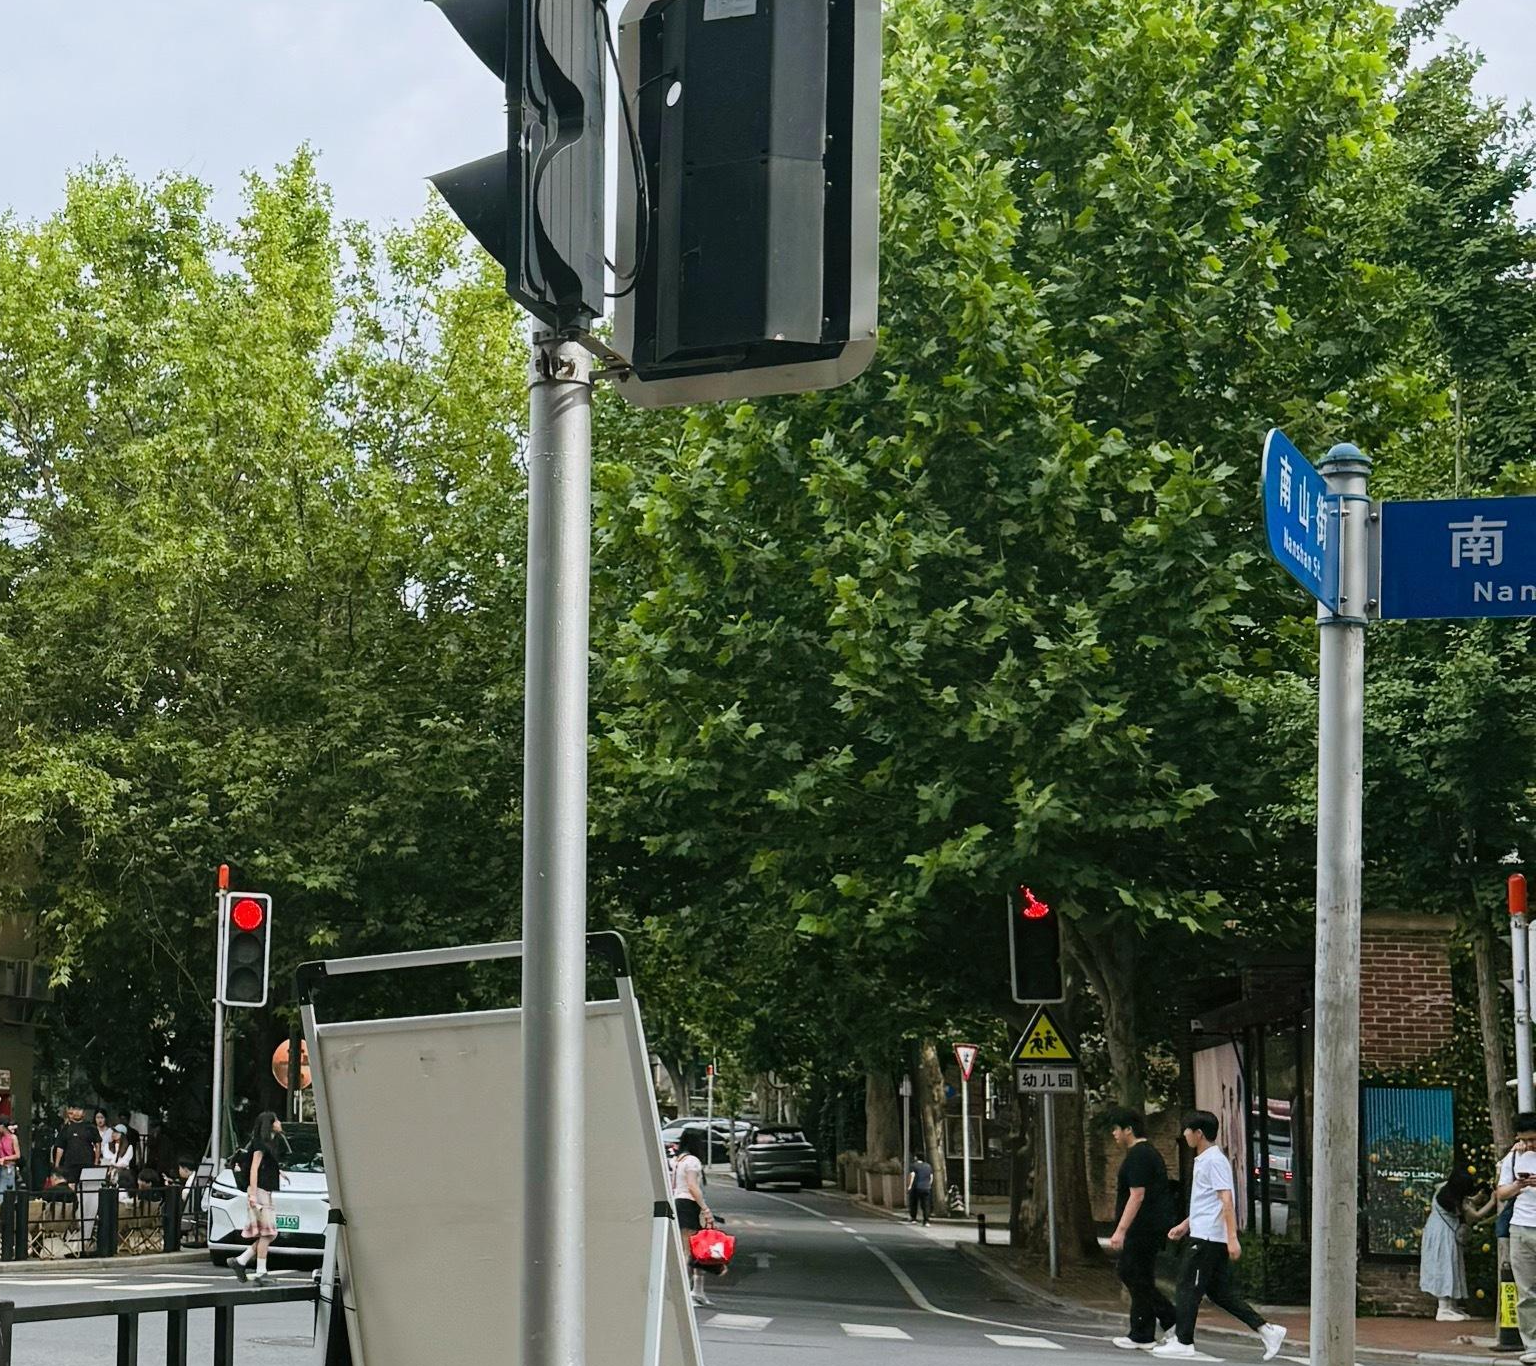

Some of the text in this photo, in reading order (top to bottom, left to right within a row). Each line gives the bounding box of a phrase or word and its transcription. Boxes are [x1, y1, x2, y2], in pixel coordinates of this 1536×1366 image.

[1279, 454, 1328, 551] 南山街
[1283, 526, 1312, 574] Nanshan
[1448, 515, 1508, 568] 南
[1473, 581, 1536, 603] Nan
[1022, 1073, 1073, 1088] 幼儿园
